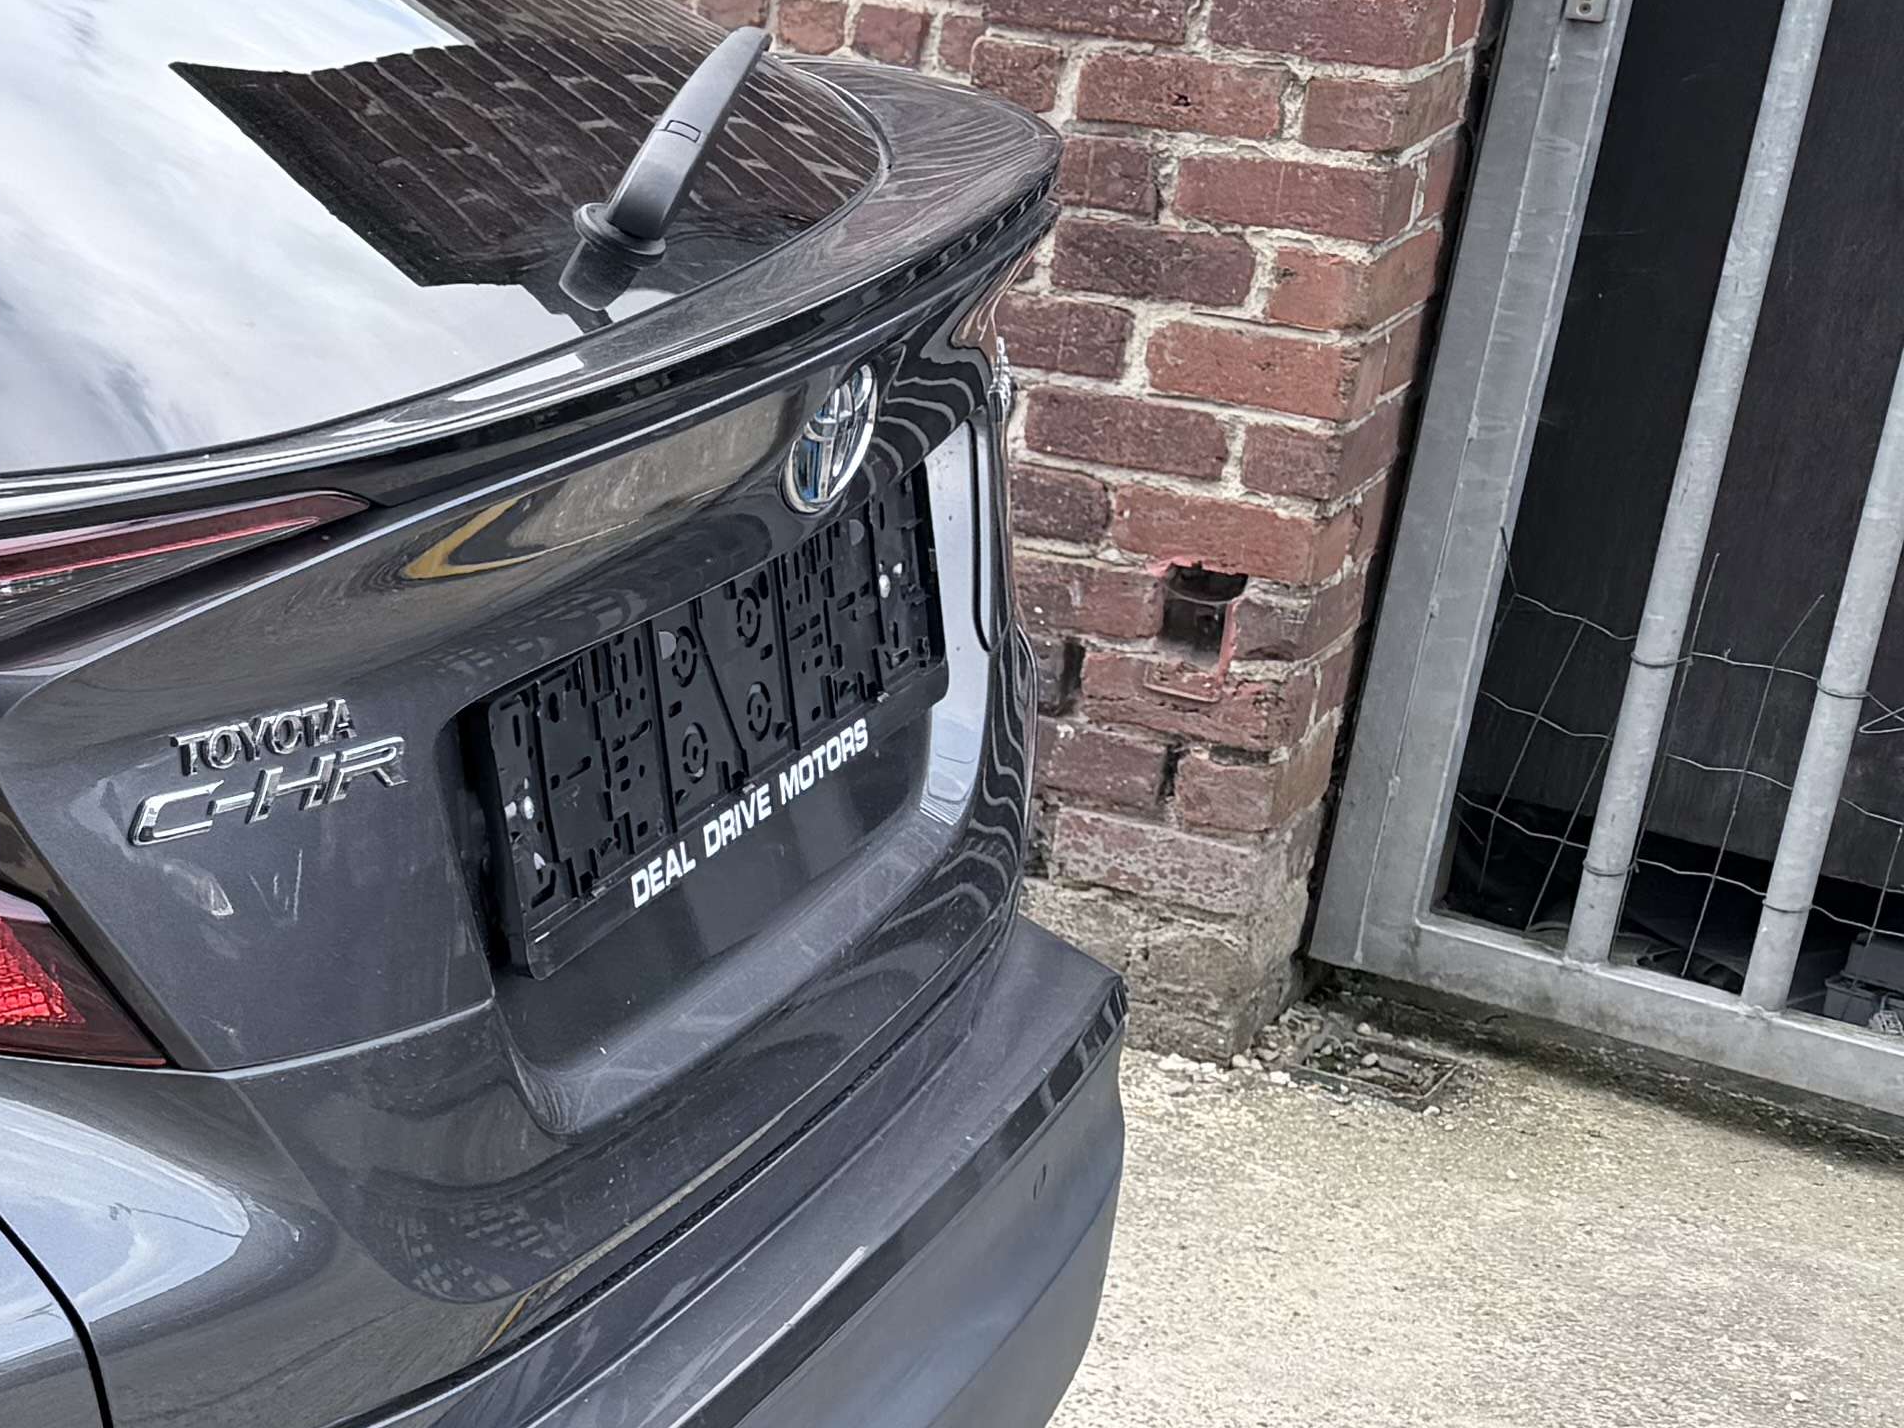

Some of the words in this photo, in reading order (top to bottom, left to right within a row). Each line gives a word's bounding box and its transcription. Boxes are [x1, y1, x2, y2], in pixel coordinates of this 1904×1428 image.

[128, 735, 409, 846] C-HR
[169, 698, 358, 776] TOYOTA
[630, 841, 697, 909] DEAL
[702, 783, 773, 858] DRIVE
[778, 718, 869, 805] MOTORS
